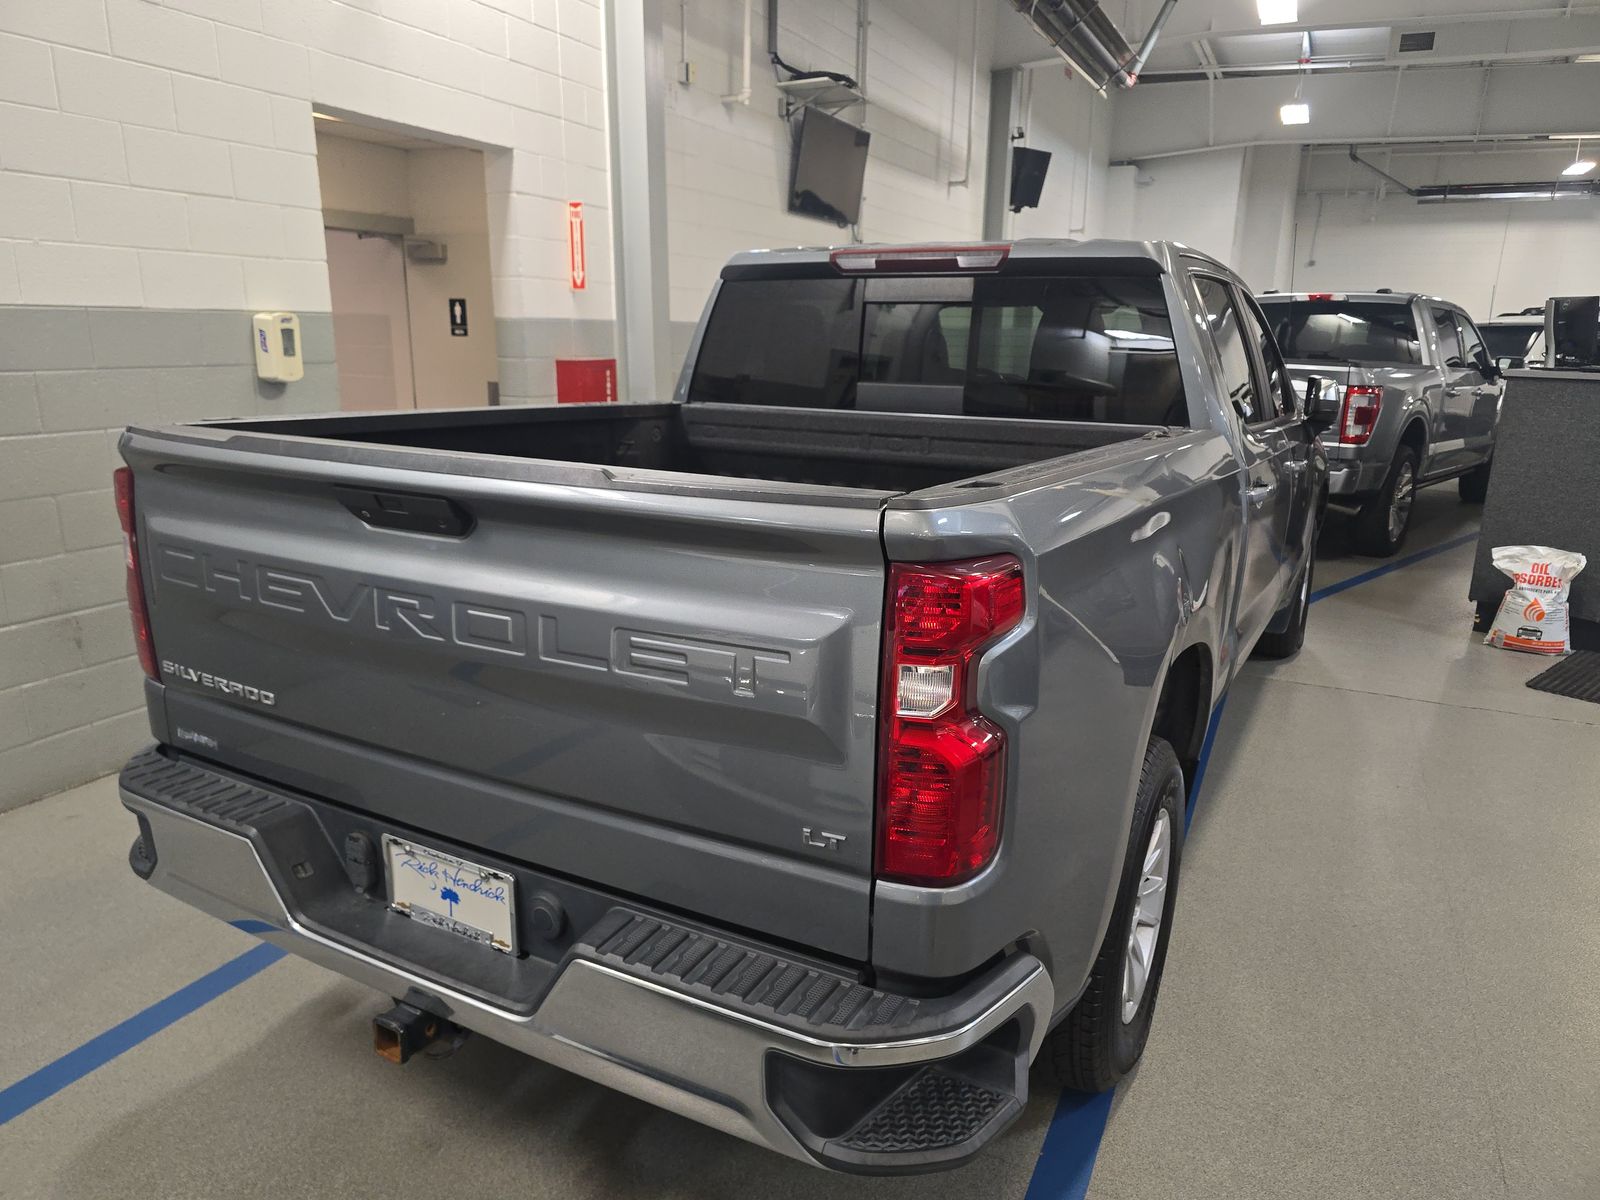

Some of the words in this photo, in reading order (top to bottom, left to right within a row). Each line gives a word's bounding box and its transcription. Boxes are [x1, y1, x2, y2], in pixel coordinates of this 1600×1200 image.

[1531, 562, 1550, 576] OIL
[160, 543, 791, 698] CHEVROLET
[161, 659, 276, 706] SILVERADO
[802, 827, 846, 849] LT
[395, 850, 440, 879] Rick
[442, 865, 506, 905] Hendrick
